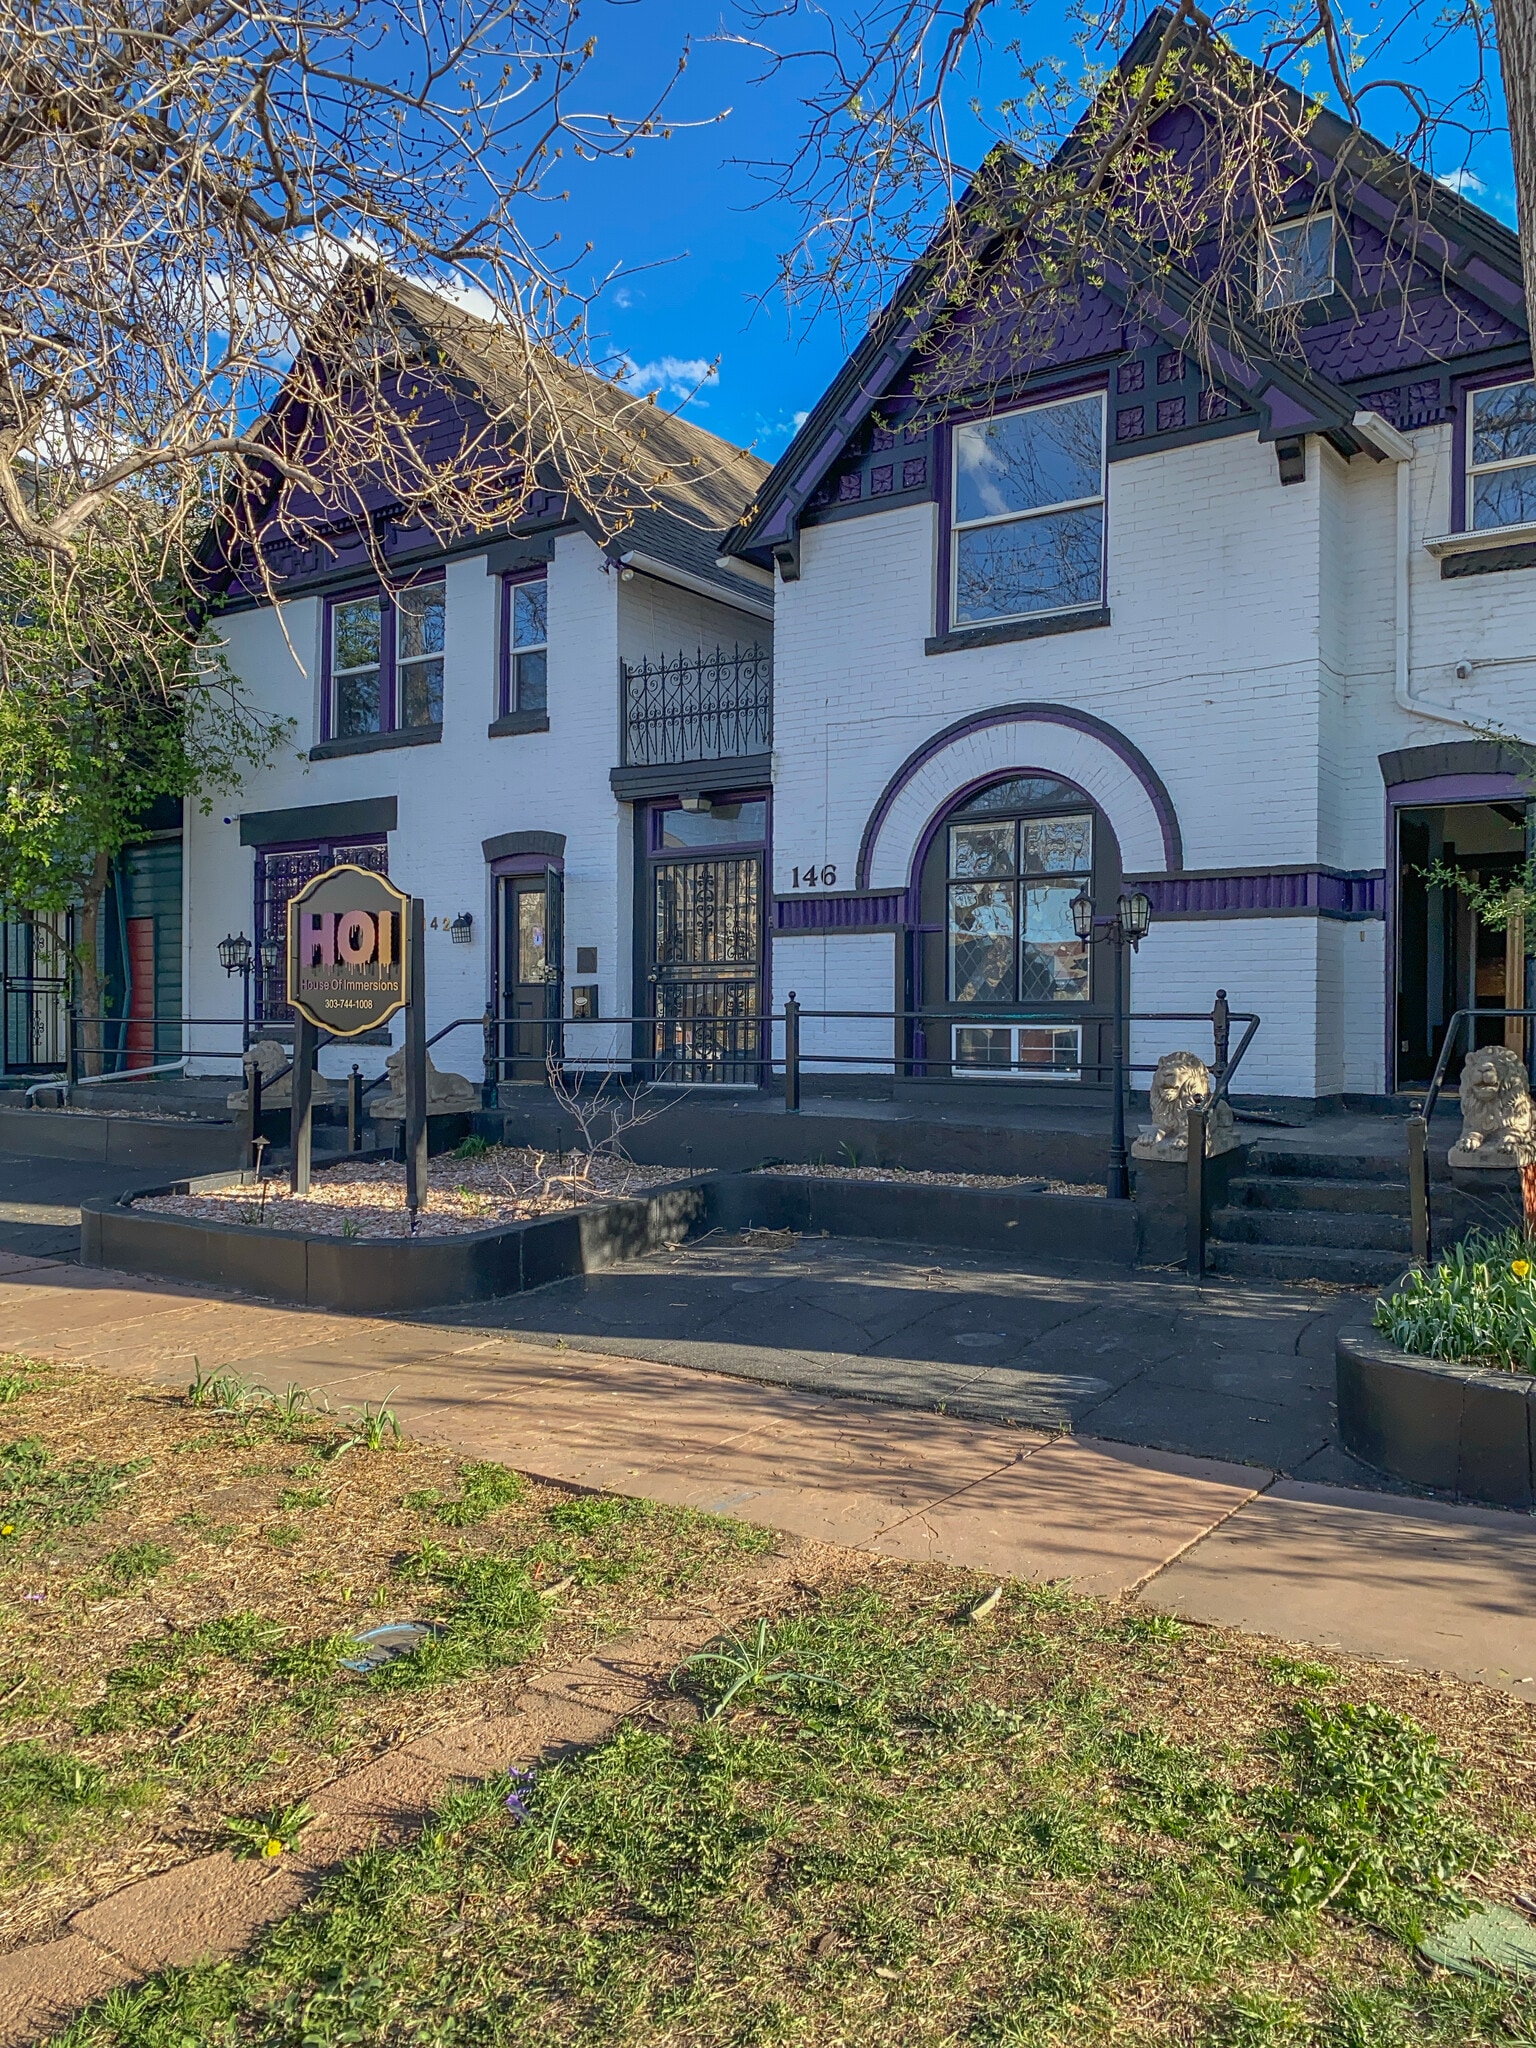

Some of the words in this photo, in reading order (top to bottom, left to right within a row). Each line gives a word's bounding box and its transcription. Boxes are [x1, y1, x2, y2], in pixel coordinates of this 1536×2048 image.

[791, 864, 837, 888] 146
[301, 910, 393, 972] HOI
[301, 979, 330, 991] House
[331, 979, 343, 991] Of
[344, 979, 399, 991] Immersions
[325, 999, 374, 1009] 303-744-1008
